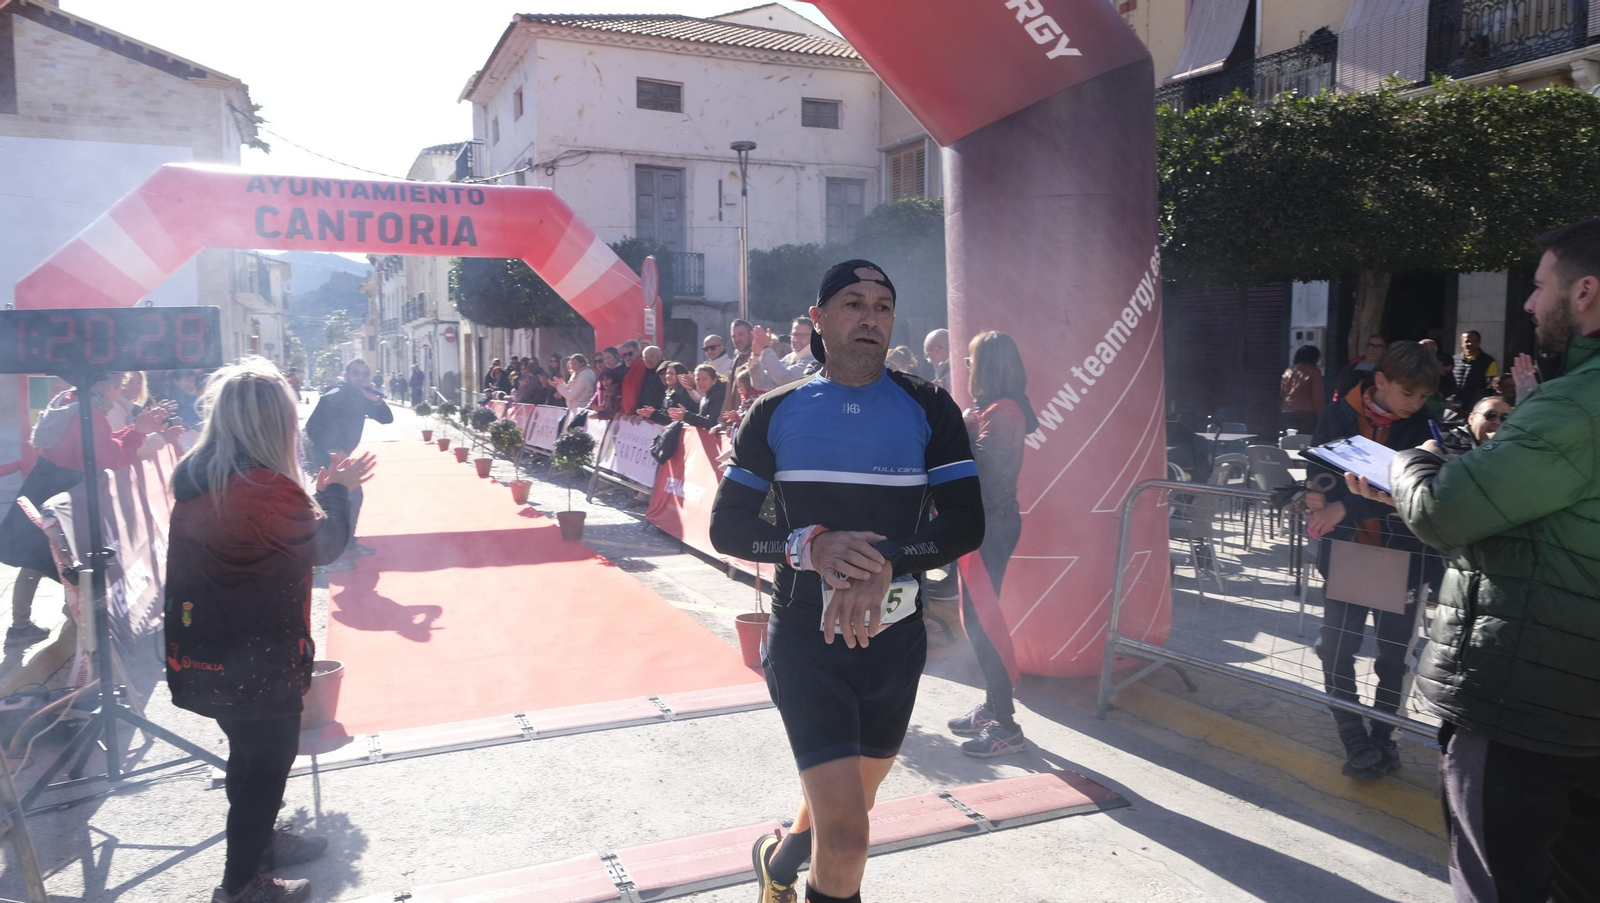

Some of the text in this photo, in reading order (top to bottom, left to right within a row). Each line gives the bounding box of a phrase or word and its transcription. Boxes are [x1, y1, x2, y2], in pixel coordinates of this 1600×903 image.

[246, 176, 485, 206] AYUNTAMIENTO
[254, 205, 479, 247] CANTORIA
[872, 465, 897, 473] FULL
